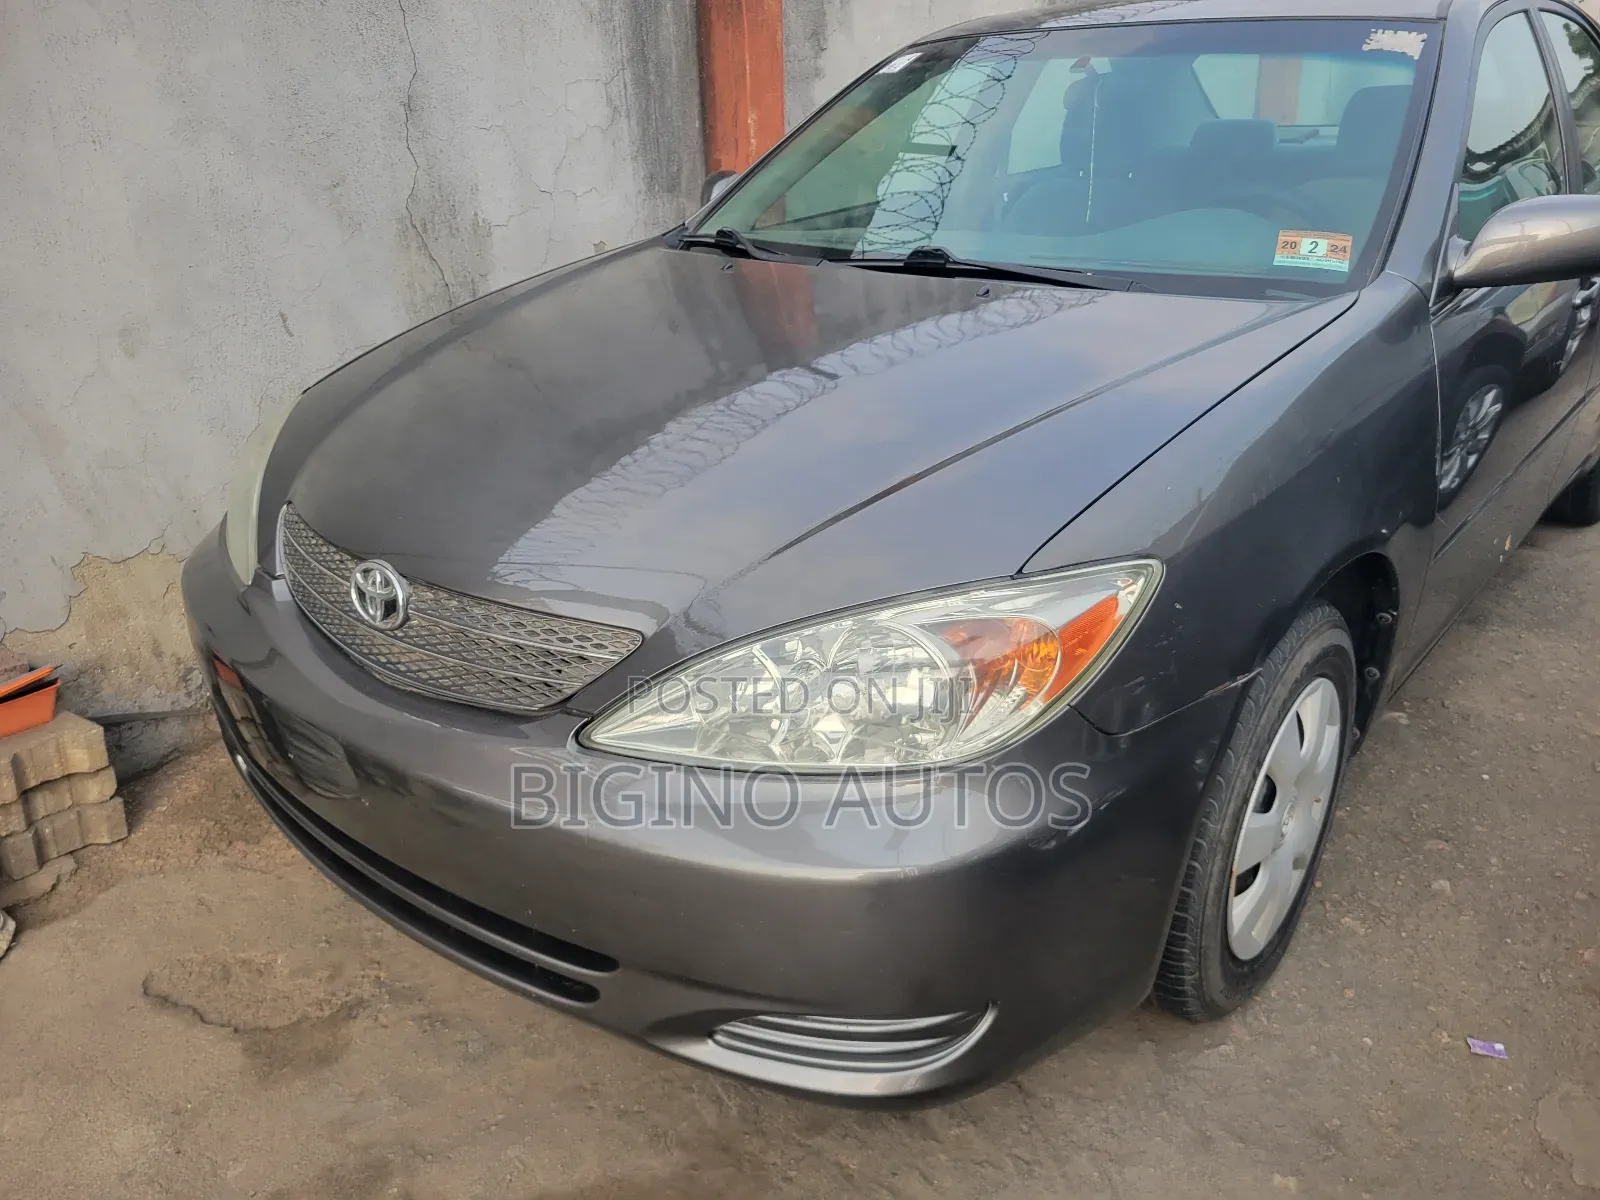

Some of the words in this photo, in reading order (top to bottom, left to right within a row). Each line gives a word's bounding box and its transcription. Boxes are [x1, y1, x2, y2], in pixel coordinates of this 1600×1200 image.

[1281, 241, 1297, 250] 20
[1308, 240, 1319, 254] 2
[1331, 244, 1347, 254] 24
